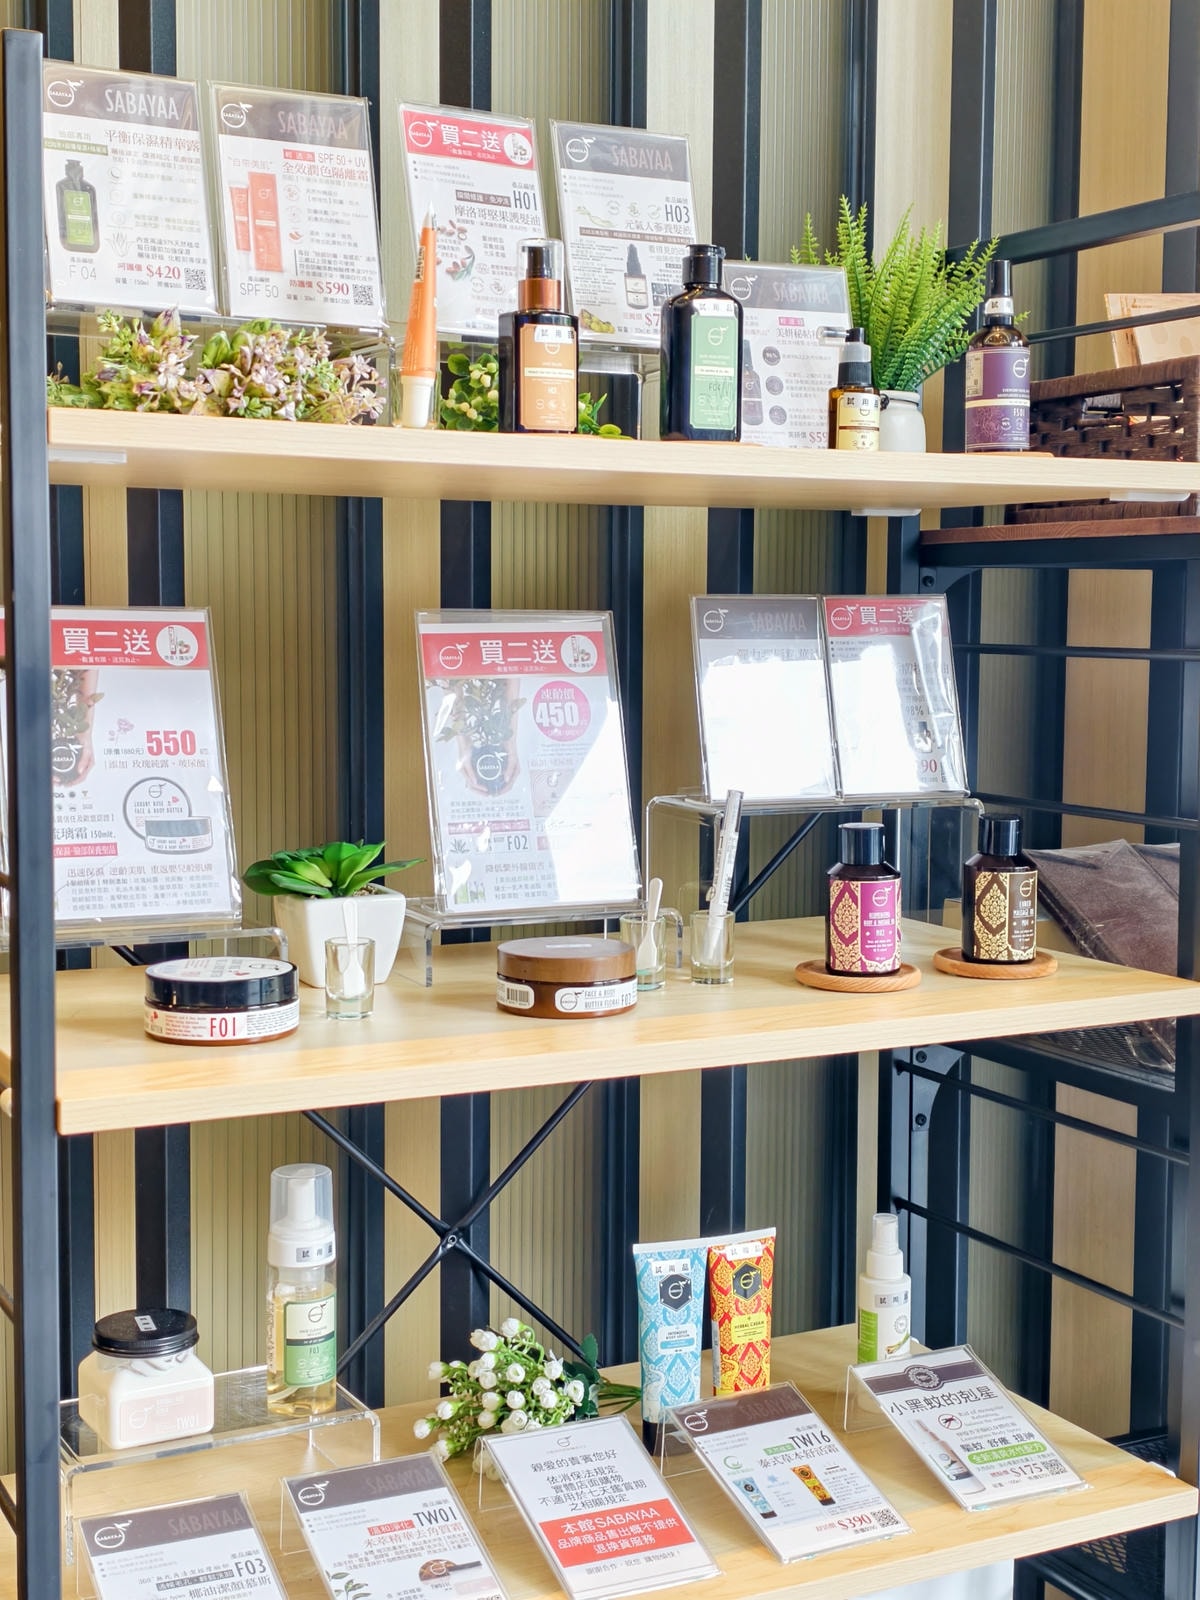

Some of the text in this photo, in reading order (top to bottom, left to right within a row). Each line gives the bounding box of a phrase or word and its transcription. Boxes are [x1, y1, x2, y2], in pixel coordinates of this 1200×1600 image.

[104, 89, 180, 120] SABAYAA
[278, 111, 348, 140] SABAYAA
[104, 129, 200, 154] 平衡保濕精華露
[440, 124, 502, 153] 買二送
[318, 154, 333, 165] SPF
[354, 157, 367, 168] UV
[611, 145, 673, 171] SABAYAA
[512, 190, 538, 211] H01
[664, 204, 690, 223] H03
[146, 264, 181, 280] $420
[240, 282, 279, 299] SPF 50
[316, 281, 350, 296] $590
[773, 282, 830, 305] SABAYAA
[750, 612, 808, 632] SABAYAA
[859, 606, 915, 626] 買二送
[62, 627, 152, 656] 買二送
[479, 639, 557, 665] 買二送
[535, 702, 579, 728] 450
[145, 729, 196, 756] 550
[506, 835, 529, 850] F02
[209, 1017, 236, 1038] F01
[739, 1394, 803, 1420] SABAYAA
[889, 1385, 998, 1416] 小黑蚊的剋星
[789, 1429, 832, 1450] TW16
[530, 1448, 617, 1473] 親愛的貴賓您好
[1009, 1462, 1043, 1478] $175
[365, 1466, 434, 1495] SABAYAA
[546, 1464, 618, 1485] 依消保法規定
[551, 1474, 624, 1494] 實體店面購物
[537, 1479, 648, 1507] 不適用於七天鑑賞期
[570, 1493, 630, 1512] 之相關規定
[167, 1508, 246, 1537] SABAYAA
[413, 1506, 458, 1527] TW01
[561, 1507, 661, 1536] 本館 SABAYAA
[837, 1514, 872, 1531] $390
[557, 1517, 679, 1550] 品牌商品售出概不提供
[593, 1533, 656, 1555] 退換貨服務
[234, 1558, 267, 1577] F03
